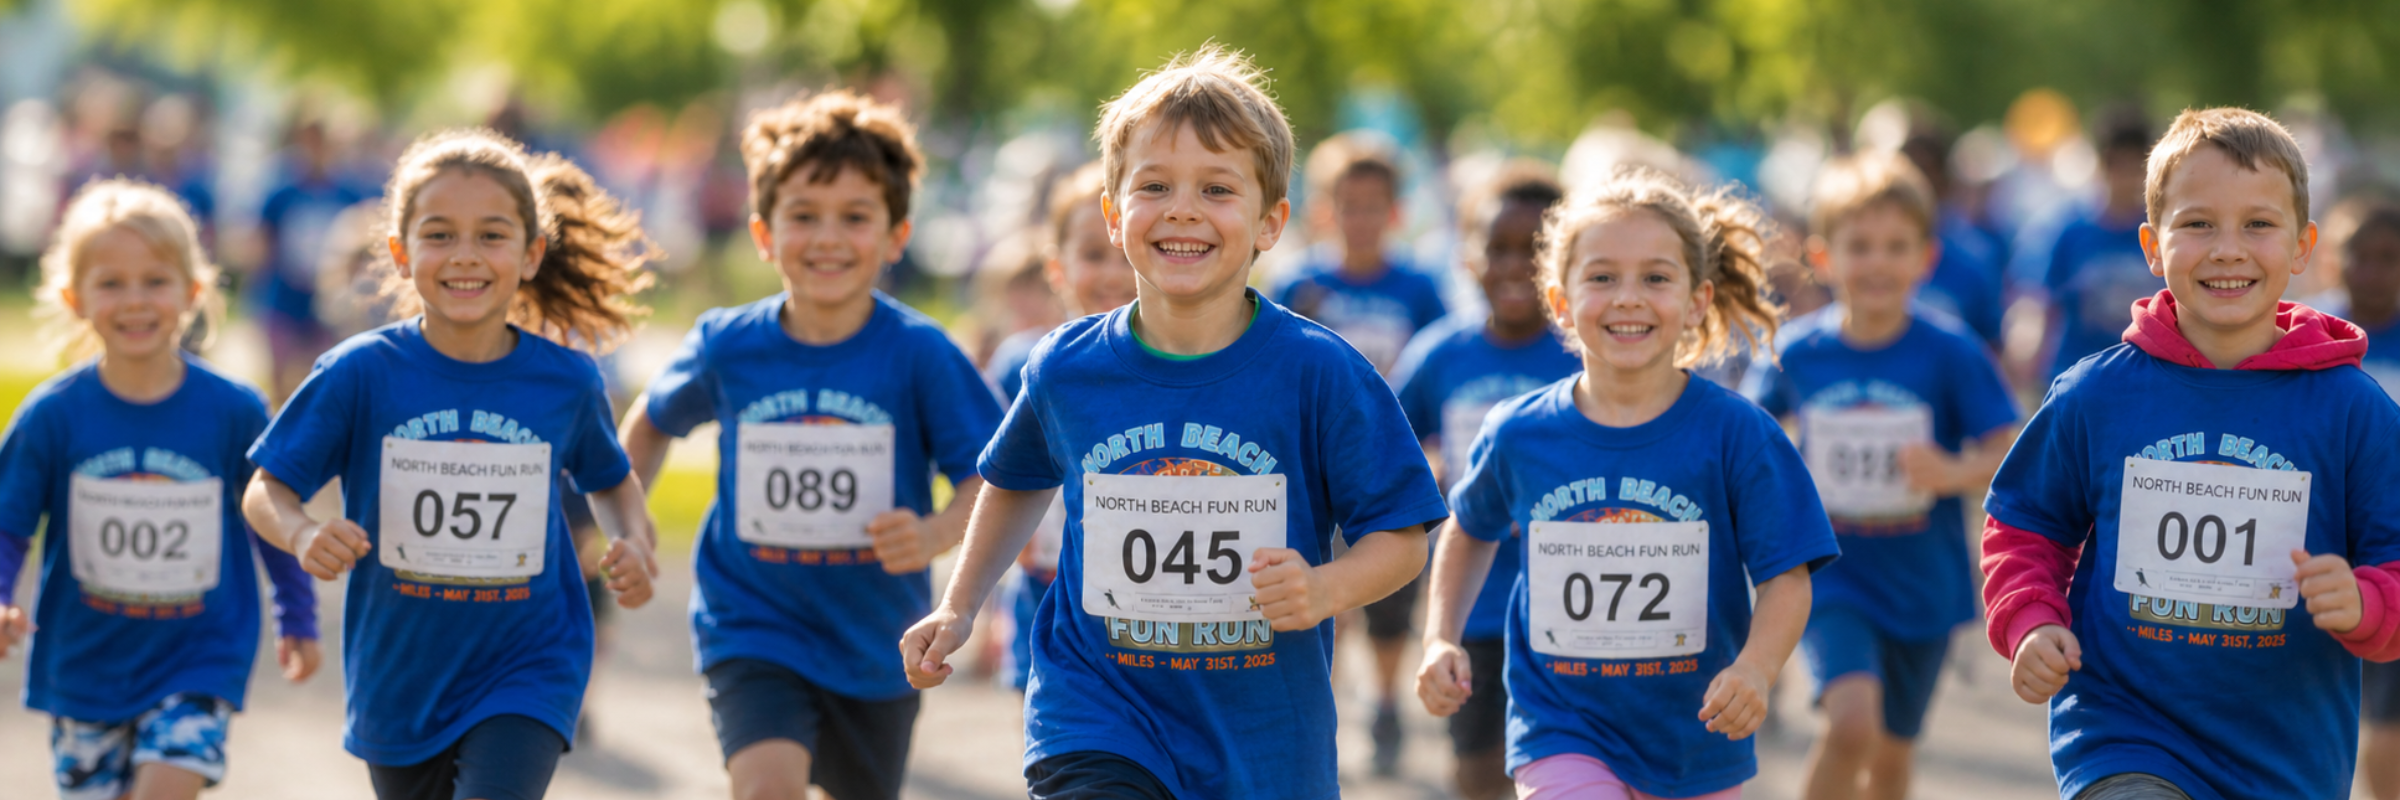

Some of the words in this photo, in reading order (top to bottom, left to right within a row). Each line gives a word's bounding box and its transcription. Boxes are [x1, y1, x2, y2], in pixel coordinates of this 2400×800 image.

[388, 409, 459, 440] ORTH
[1081, 422, 1165, 473] NORTH
[1180, 422, 1277, 475] BEACH
[2134, 431, 2205, 460] ORTH
[392, 457, 437, 474] NORTH
[440, 462, 487, 477] BEACH
[491, 464, 517, 477] FUN
[520, 462, 543, 476] RUN
[766, 467, 857, 512] 089
[1096, 495, 1146, 512] NORTH
[1151, 500, 1202, 514] BEACH
[1207, 501, 1239, 514] FUN
[1244, 498, 1276, 512] RUN
[1530, 476, 1606, 520] NORTH
[1619, 476, 1702, 521] BEACH
[2132, 475, 2182, 494] NORTH
[2186, 481, 2234, 498] BEACH
[2239, 486, 2268, 501] FUN
[2272, 489, 2302, 503] RUN
[413, 489, 517, 540] 057
[100, 517, 190, 561] 002
[1538, 542, 1583, 556] NORTH
[1587, 545, 1635, 558] BEACH
[1639, 545, 1667, 557] FUN
[1672, 543, 1700, 557] RUN
[2157, 511, 2256, 566] 001
[1122, 528, 1242, 584] 045
[1563, 572, 1671, 622] 072
[2131, 593, 2200, 621] FUN
[2212, 604, 2282, 624] RUN
[1110, 617, 1180, 645] FUN
[1193, 619, 1271, 645] RUN
[2188, 632, 2217, 647] MAY
[2221, 634, 2252, 649] 31ST,
[1118, 652, 1154, 669] MILES
[1171, 657, 1200, 670] MAY
[1205, 656, 1239, 670] 31ST,
[1244, 652, 1276, 667] 2025
[1601, 662, 1631, 677] MAY
